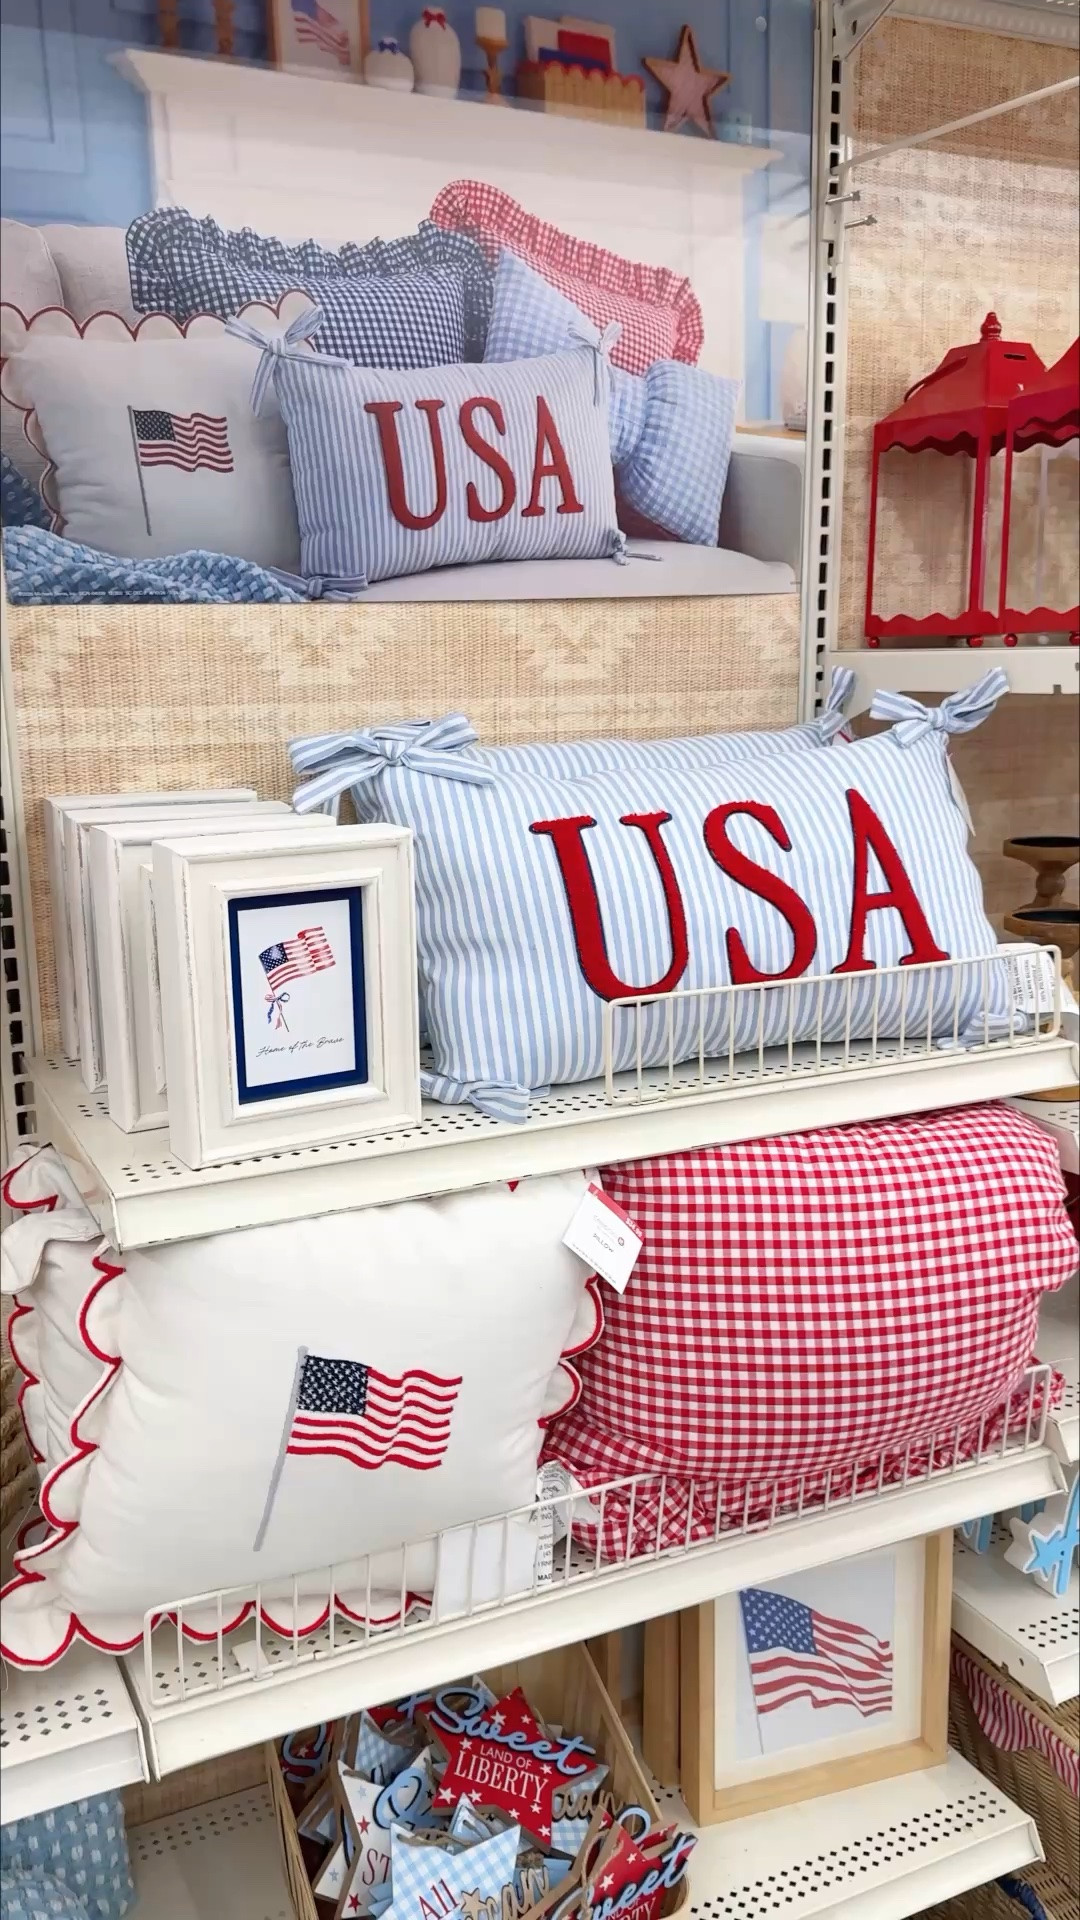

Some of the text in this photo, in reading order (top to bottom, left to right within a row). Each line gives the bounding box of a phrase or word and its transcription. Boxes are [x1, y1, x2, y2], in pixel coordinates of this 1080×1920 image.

[364, 396, 584, 530] USA
[528, 788, 951, 1007] USA
[256, 1046, 285, 1057] Home
[289, 1041, 299, 1053] of
[317, 1037, 344, 1048] Brave
[429, 1687, 596, 1775] Sweet
[480, 1744, 532, 1770] LAND OF
[454, 1750, 549, 1804] LIBERTY
[419, 1878, 459, 1920] All
